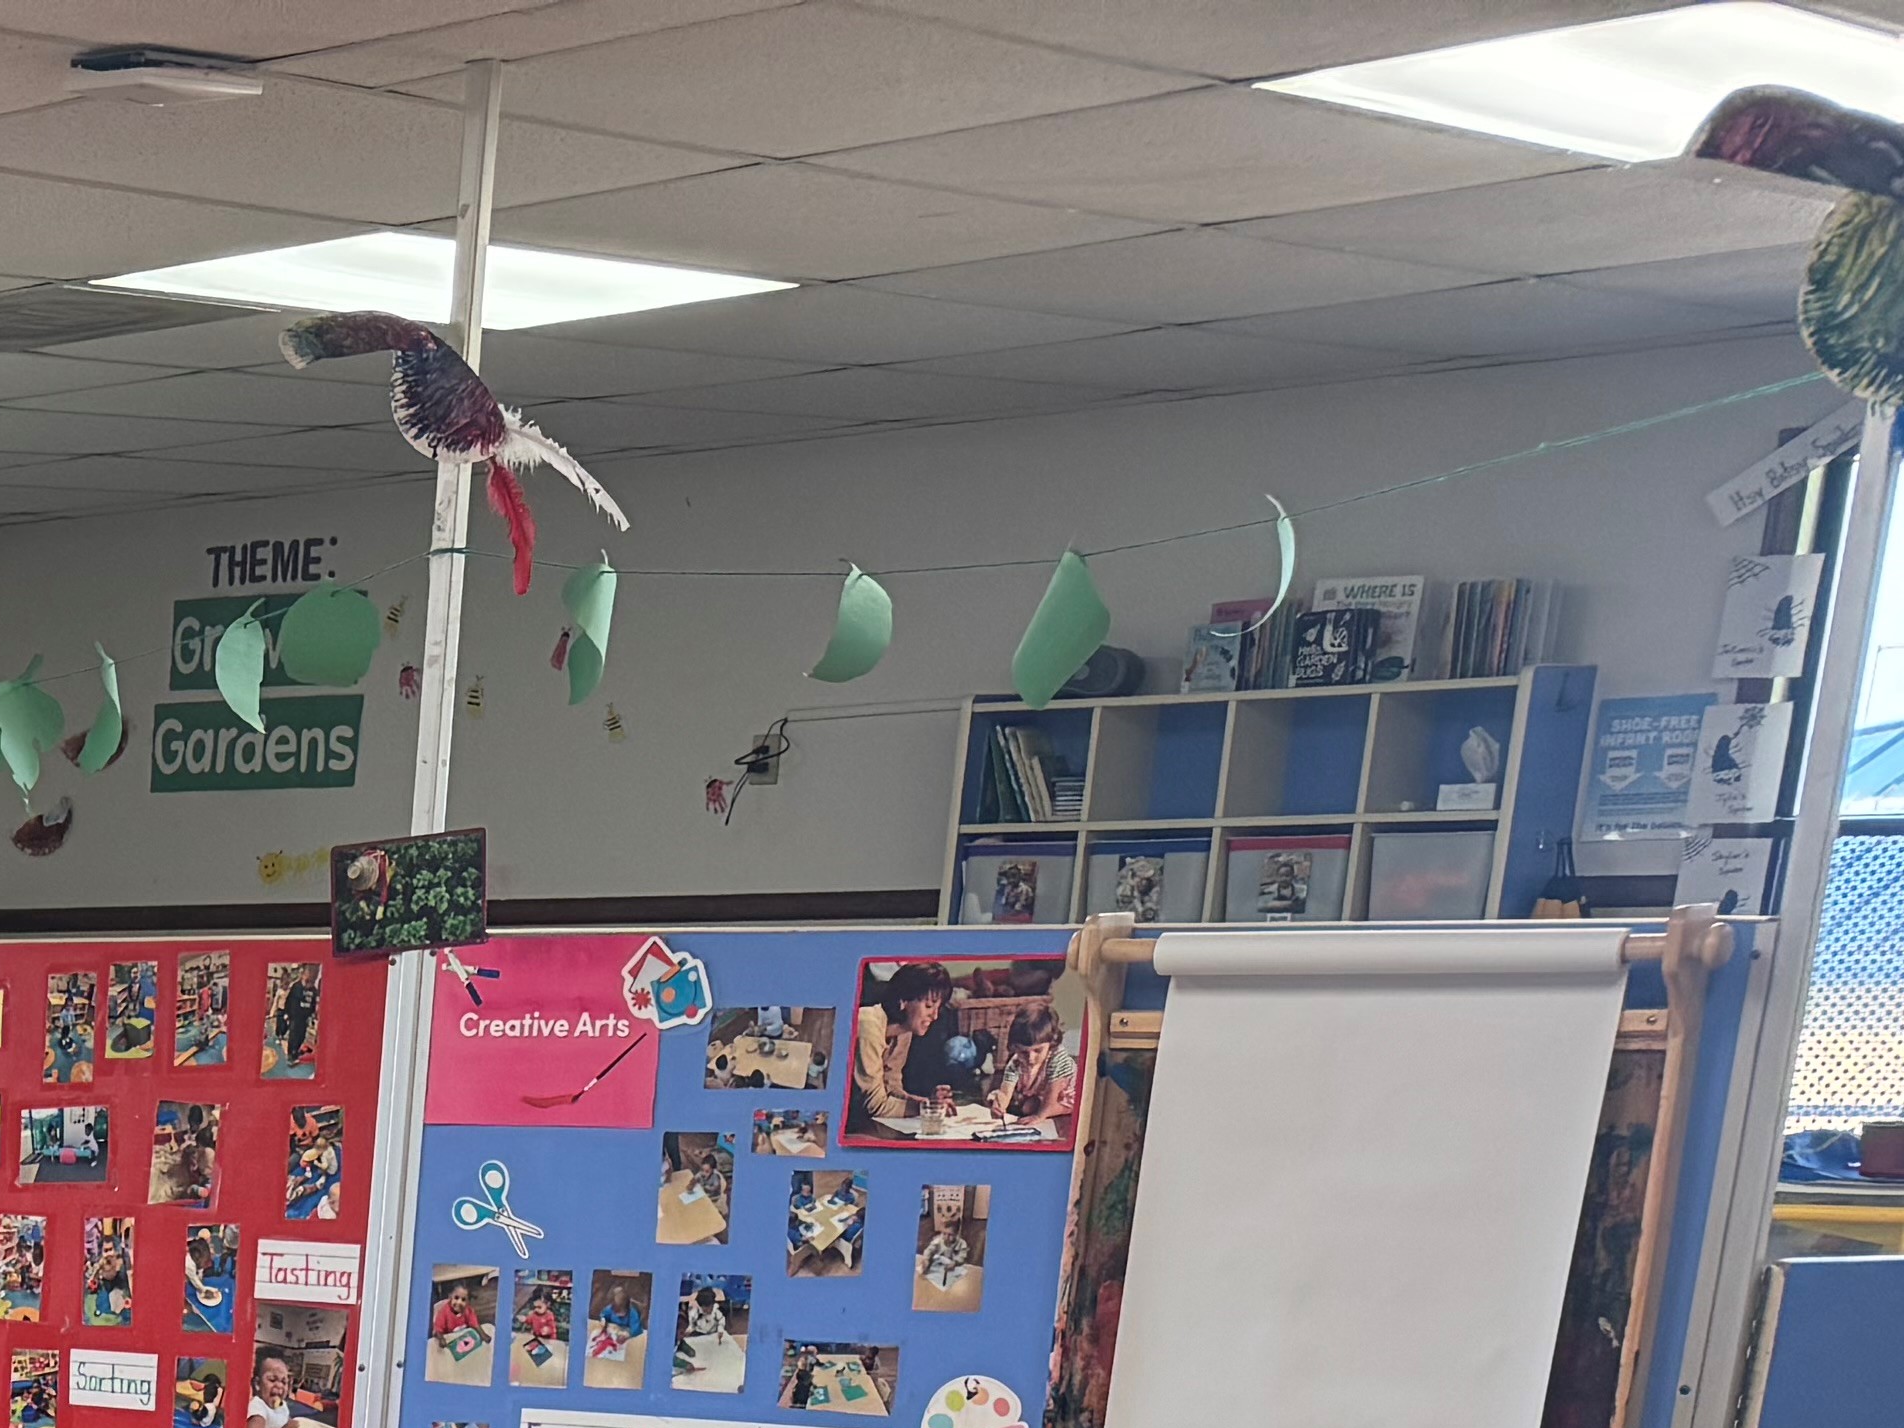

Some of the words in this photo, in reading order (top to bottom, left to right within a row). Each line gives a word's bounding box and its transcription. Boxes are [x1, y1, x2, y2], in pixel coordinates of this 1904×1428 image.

[206, 536, 338, 588] THEME:
[1343, 584, 1397, 600] WHERE
[1401, 583, 1417, 597] IS
[1600, 730, 1658, 748] INFANT
[1610, 715, 1700, 733] SHOE-FREE
[154, 714, 355, 776] Gardens
[459, 1011, 569, 1038] Creative
[573, 1011, 630, 1038] Arts
[262, 1252, 356, 1301] Tasting
[76, 1360, 152, 1399] Sorting
